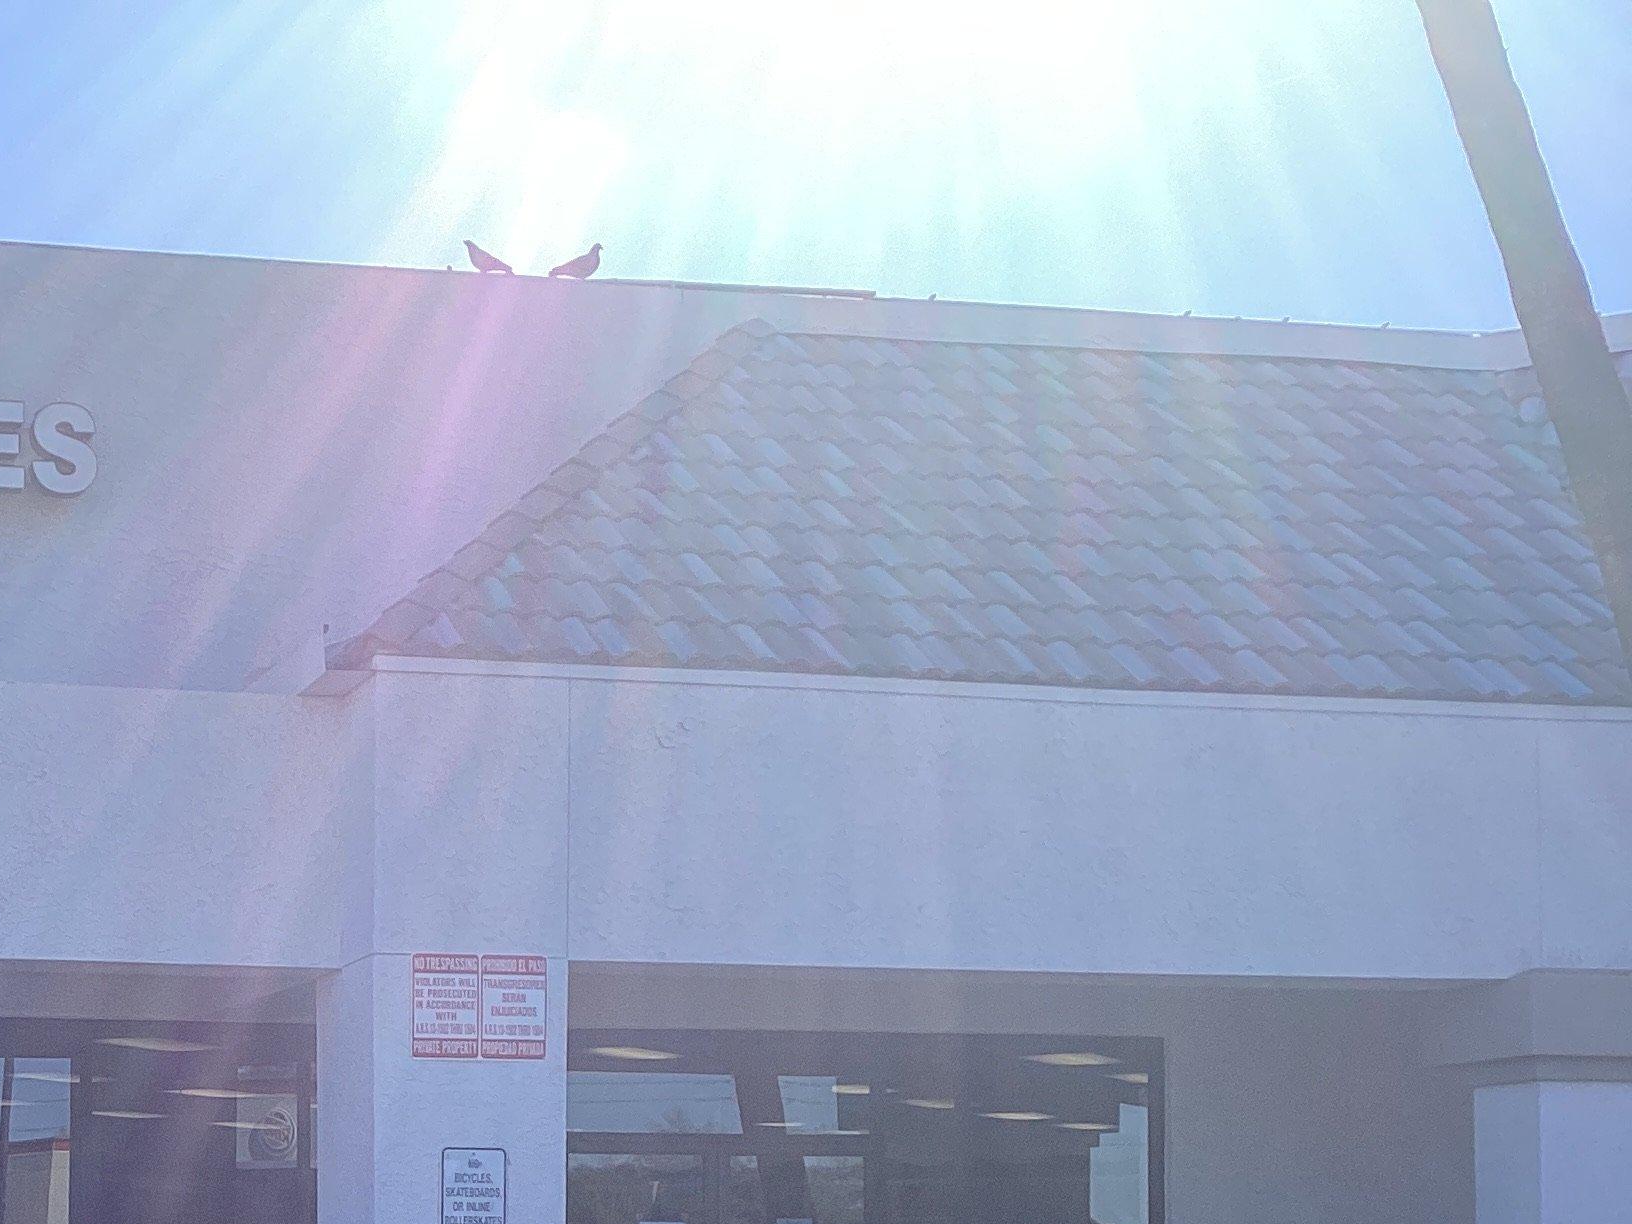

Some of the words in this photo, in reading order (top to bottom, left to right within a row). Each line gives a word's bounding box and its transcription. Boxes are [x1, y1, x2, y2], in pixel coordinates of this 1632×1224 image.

[415, 978, 456, 987] VIOLATORS
[415, 989, 425, 998] BE
[427, 989, 477, 999] PROSECUTED
[426, 1000, 476, 1010] ACCORDANCE
[435, 1012, 457, 1021] WITH
[452, 1201, 464, 1212] OR
[466, 1201, 491, 1212] INLINE
